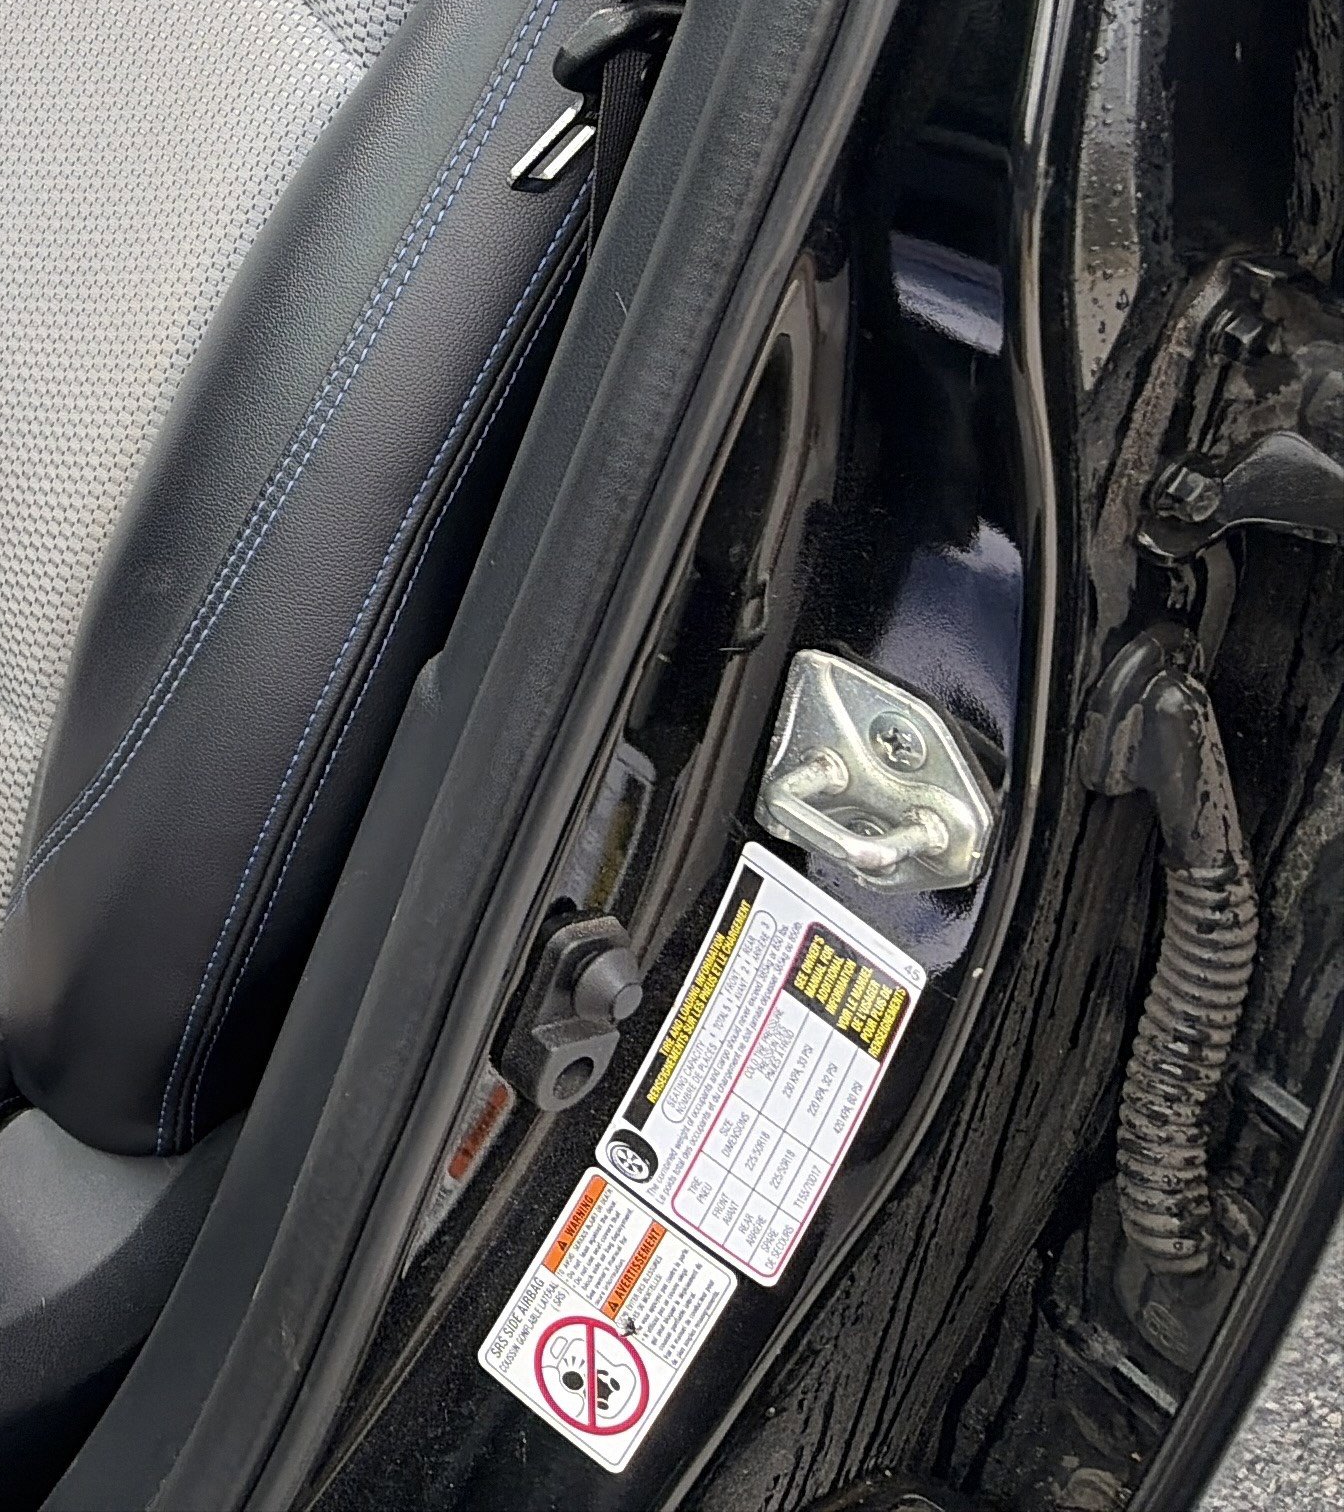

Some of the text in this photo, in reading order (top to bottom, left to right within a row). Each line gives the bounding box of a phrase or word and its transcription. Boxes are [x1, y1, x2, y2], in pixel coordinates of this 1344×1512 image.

[760, 920, 770, 929] 3
[741, 934, 757, 955] REAR
[768, 949, 777, 959] or
[740, 964, 750, 974] 2
[793, 933, 825, 990] SEE OWNER'S
[803, 943, 835, 998] MANUAL FOR
[723, 968, 741, 994] FRONT
[731, 976, 748, 1000] AVANT
[814, 952, 845, 1004] ADDITIONAL
[823, 957, 857, 1015] INFORMATION
[646, 898, 752, 1105] RENSEIGNEMENTS SUR LES PNEUS ET LE CHARGEMENT
[659, 931, 725, 1057] TIRE AND LOADING INFORMATION
[745, 979, 763, 1007] exceed
[835, 963, 873, 1031] VOIR LE MANUEL
[850, 978, 881, 1032] DE L'USAGER
[713, 1003, 731, 1030] TOTAL 5
[737, 1005, 751, 1027] never
[746, 1003, 764, 1029] jamais
[859, 983, 893, 1043] POUR PLUS DE
[866, 985, 908, 1058] RENSEIGNEMENTS
[725, 1024, 742, 1050] should
[737, 1041, 746, 1053] ne
[739, 1026, 752, 1043] doit
[715, 1047, 731, 1071] cargo
[796, 1054, 807, 1068] 33
[800, 1042, 813, 1058] PSI
[666, 1038, 706, 1109] SEATING CAPACITY
[674, 1041, 717, 1116] NOMBRE DE PLACES
[707, 1067, 720, 1084] and
[715, 1049, 742, 1094] chargement
[743, 1057, 759, 1079] COLD
[820, 1073, 832, 1086] 32
[825, 1060, 838, 1077] PSI
[689, 1080, 715, 1120] occupants
[710, 1091, 721, 1103] du
[781, 1080, 795, 1098] 230
[850, 1080, 863, 1095] PSI
[706, 1100, 715, 1111] et
[806, 1098, 820, 1117] 220
[685, 1115, 695, 1127] of
[688, 1108, 712, 1148] occupants
[718, 1117, 733, 1137] SIZE
[720, 1109, 750, 1158] DIMENSIONS
[672, 1123, 692, 1152] weight
[681, 1144, 692, 1160] des
[653, 1146, 678, 1185] combined
[672, 1157, 685, 1175] total
[645, 1181, 659, 1198] The
[662, 1173, 677, 1196] poids
[686, 1175, 702, 1196] TIRE
[696, 1180, 712, 1205] PNEU
[657, 1193, 667, 1205] Le
[711, 1191, 730, 1219] FRONT
[563, 1193, 594, 1237] WARNING
[721, 1200, 739, 1226] AVANT
[737, 1211, 754, 1235] REAR
[566, 1269, 575, 1279] Do
[572, 1258, 581, 1269] not
[599, 1213, 608, 1223] the
[573, 1274, 582, 1285] Do
[578, 1264, 588, 1276] not
[610, 1210, 621, 1223] that
[760, 1226, 778, 1253] SPARE
[764, 1222, 794, 1270] DE SECOURS
[613, 1227, 661, 1299] AVERTISSEMENT
[581, 1273, 594, 1290] block
[489, 1275, 545, 1359] SRS SIDE AIRBAG
[498, 1342, 521, 1373] COUSSIN
[515, 1306, 542, 1345] GONFLABLE
